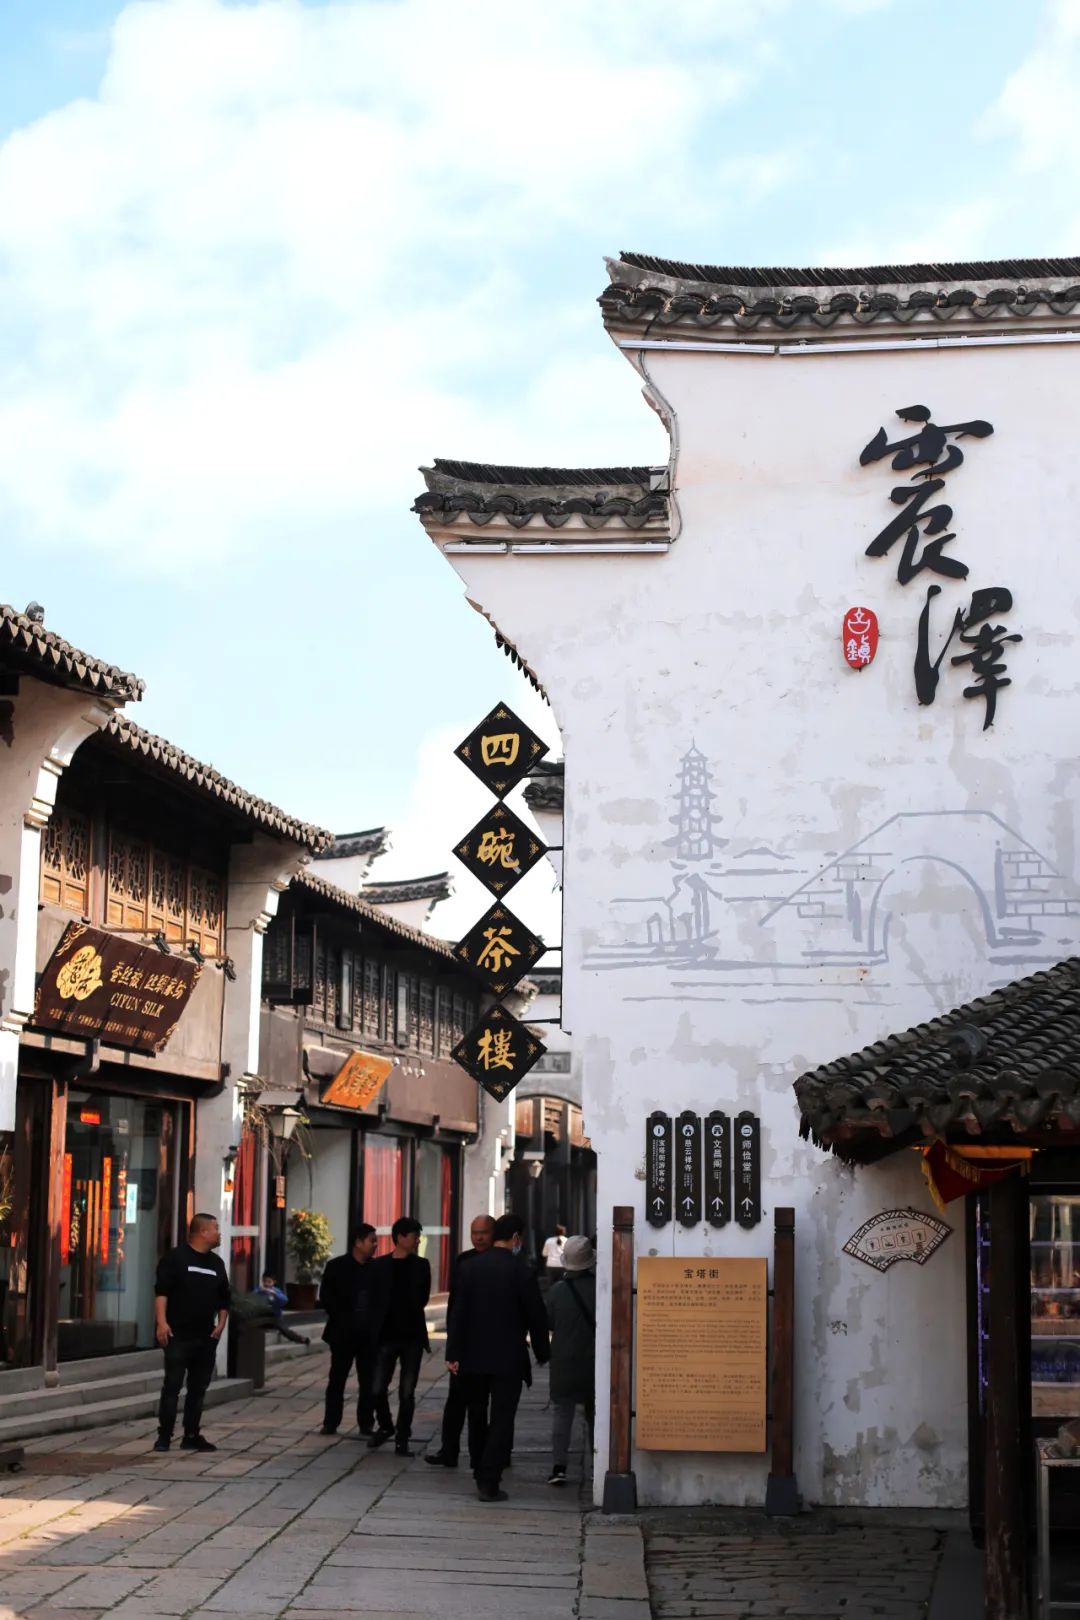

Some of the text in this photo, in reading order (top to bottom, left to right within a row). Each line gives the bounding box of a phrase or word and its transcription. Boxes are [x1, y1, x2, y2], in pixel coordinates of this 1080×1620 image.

[110, 992, 165, 1018] CIYUN SILK
[683, 1268, 720, 1279] 宝塔街
